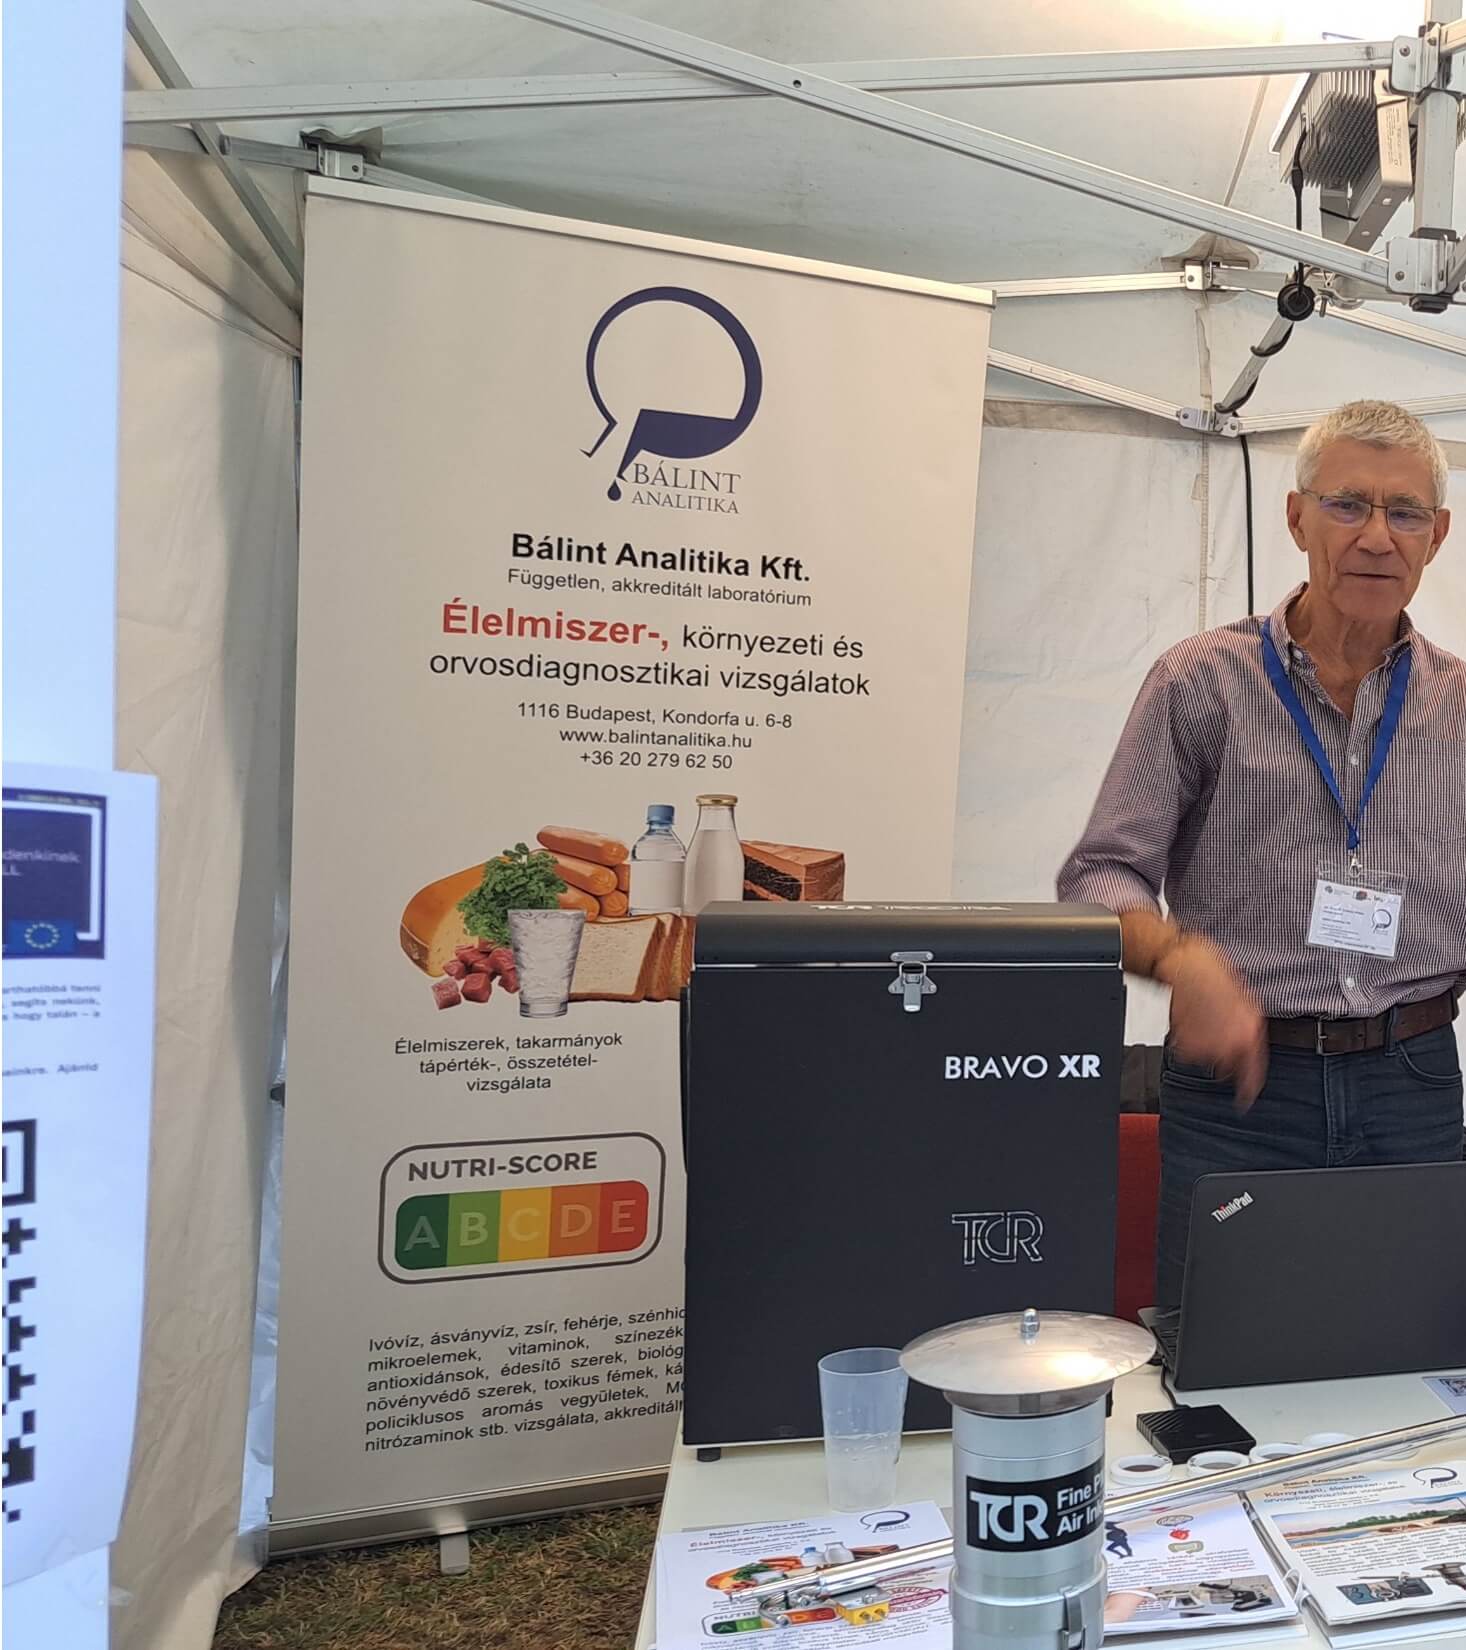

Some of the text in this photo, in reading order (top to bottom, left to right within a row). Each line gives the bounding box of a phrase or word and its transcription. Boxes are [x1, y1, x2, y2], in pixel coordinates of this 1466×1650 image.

[633, 459, 742, 496] BÁLINT
[631, 490, 739, 515] ANALITIKA
[512, 532, 810, 582] Bálint Analitika Kft.
[507, 568, 812, 607] Független, akkreditált laboratórium
[442, 597, 864, 659] Élelmiszer-, környezeti és
[429, 653, 870, 698] orvosdiagnosztikai vizsgálatok
[518, 701, 793, 729] 1116 Budapest, Kondorfa u. 6-8
[559, 728, 752, 748] www.balintanalitika.hu
[579, 750, 733, 770] +36 20 279 62 50
[394, 1032, 623, 1055] Élelmiszerek, takarmányok
[419, 1053, 598, 1076] tápérték-, összetétel-
[944, 1054, 1101, 1079] BRAVO XR
[466, 1075, 552, 1094] vizsgálata
[408, 1150, 598, 1182] NUTRI-SCORE
[458, 1211, 489, 1246] B
[507, 1207, 541, 1242] C
[560, 1203, 592, 1239] D
[610, 1199, 637, 1233] E
[1211, 1191, 1254, 1222] ThinkPad
[951, 1210, 1043, 1264] TCR
[367, 1326, 684, 1373] mikroelemek, vitaminok, színezék
[369, 1334, 425, 1353] Ivóvíz,
[429, 1324, 519, 1346] ásványvíz,
[524, 1319, 558, 1336] zsír,
[563, 1313, 623, 1332] fehérje,
[366, 1386, 471, 1413] növényvédő
[476, 1380, 537, 1399] szerek,
[544, 1374, 600, 1391] toxikus
[606, 1365, 659, 1383] fémek,
[367, 1366, 489, 1393] antioxidánsok,
[500, 1357, 561, 1377] édesítő
[570, 1350, 628, 1369] szerek,
[365, 1410, 465, 1436] policiklusos
[481, 1398, 544, 1418] aromás
[559, 1385, 649, 1409] vegyületek,
[364, 1426, 474, 1452] nitrózaminok
[479, 1422, 509, 1438] stb.
[513, 1411, 599, 1433] vizsgálata,
[1056, 1483, 1092, 1510] Fine
[969, 1490, 1050, 1543] TCR
[1056, 1512, 1086, 1537] Air
